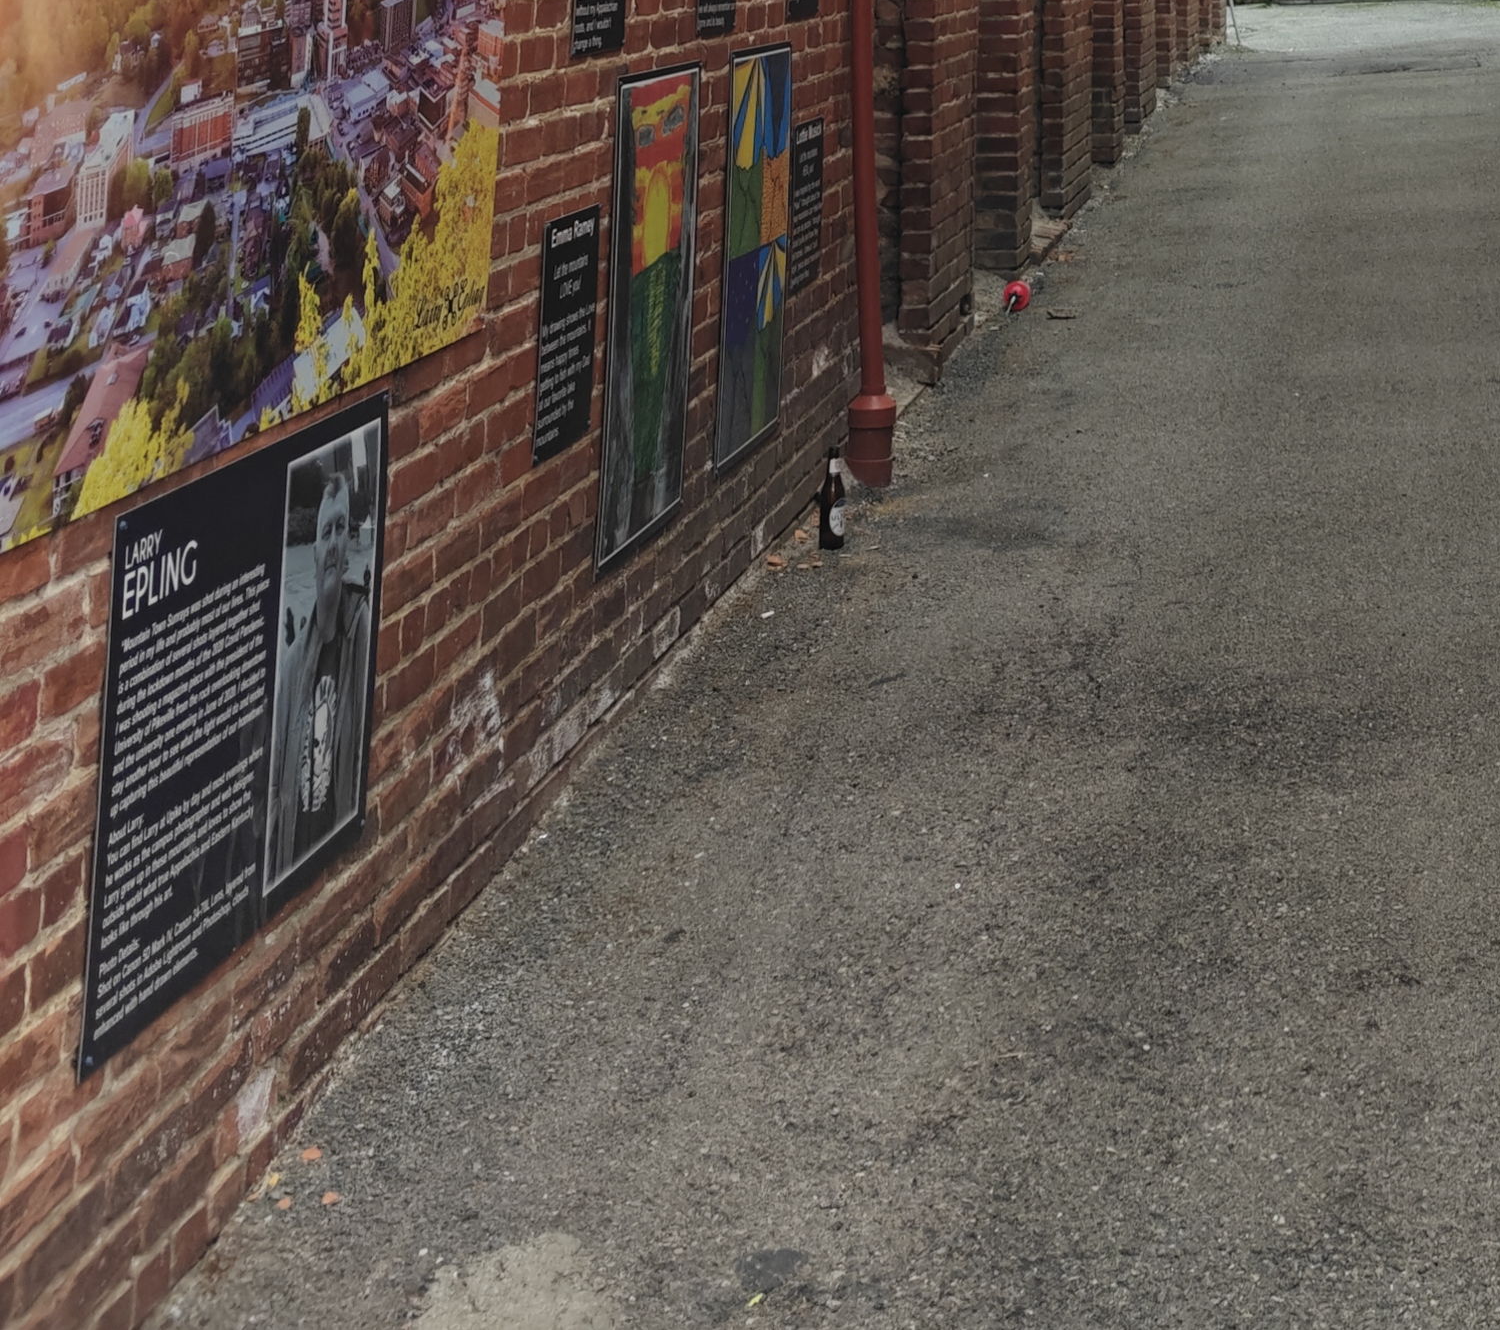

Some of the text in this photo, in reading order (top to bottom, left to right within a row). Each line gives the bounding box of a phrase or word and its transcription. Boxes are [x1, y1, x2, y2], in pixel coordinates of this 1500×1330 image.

[551, 227, 573, 248] Emma
[124, 529, 163, 570] LARRY
[121, 539, 198, 620] EPLING
